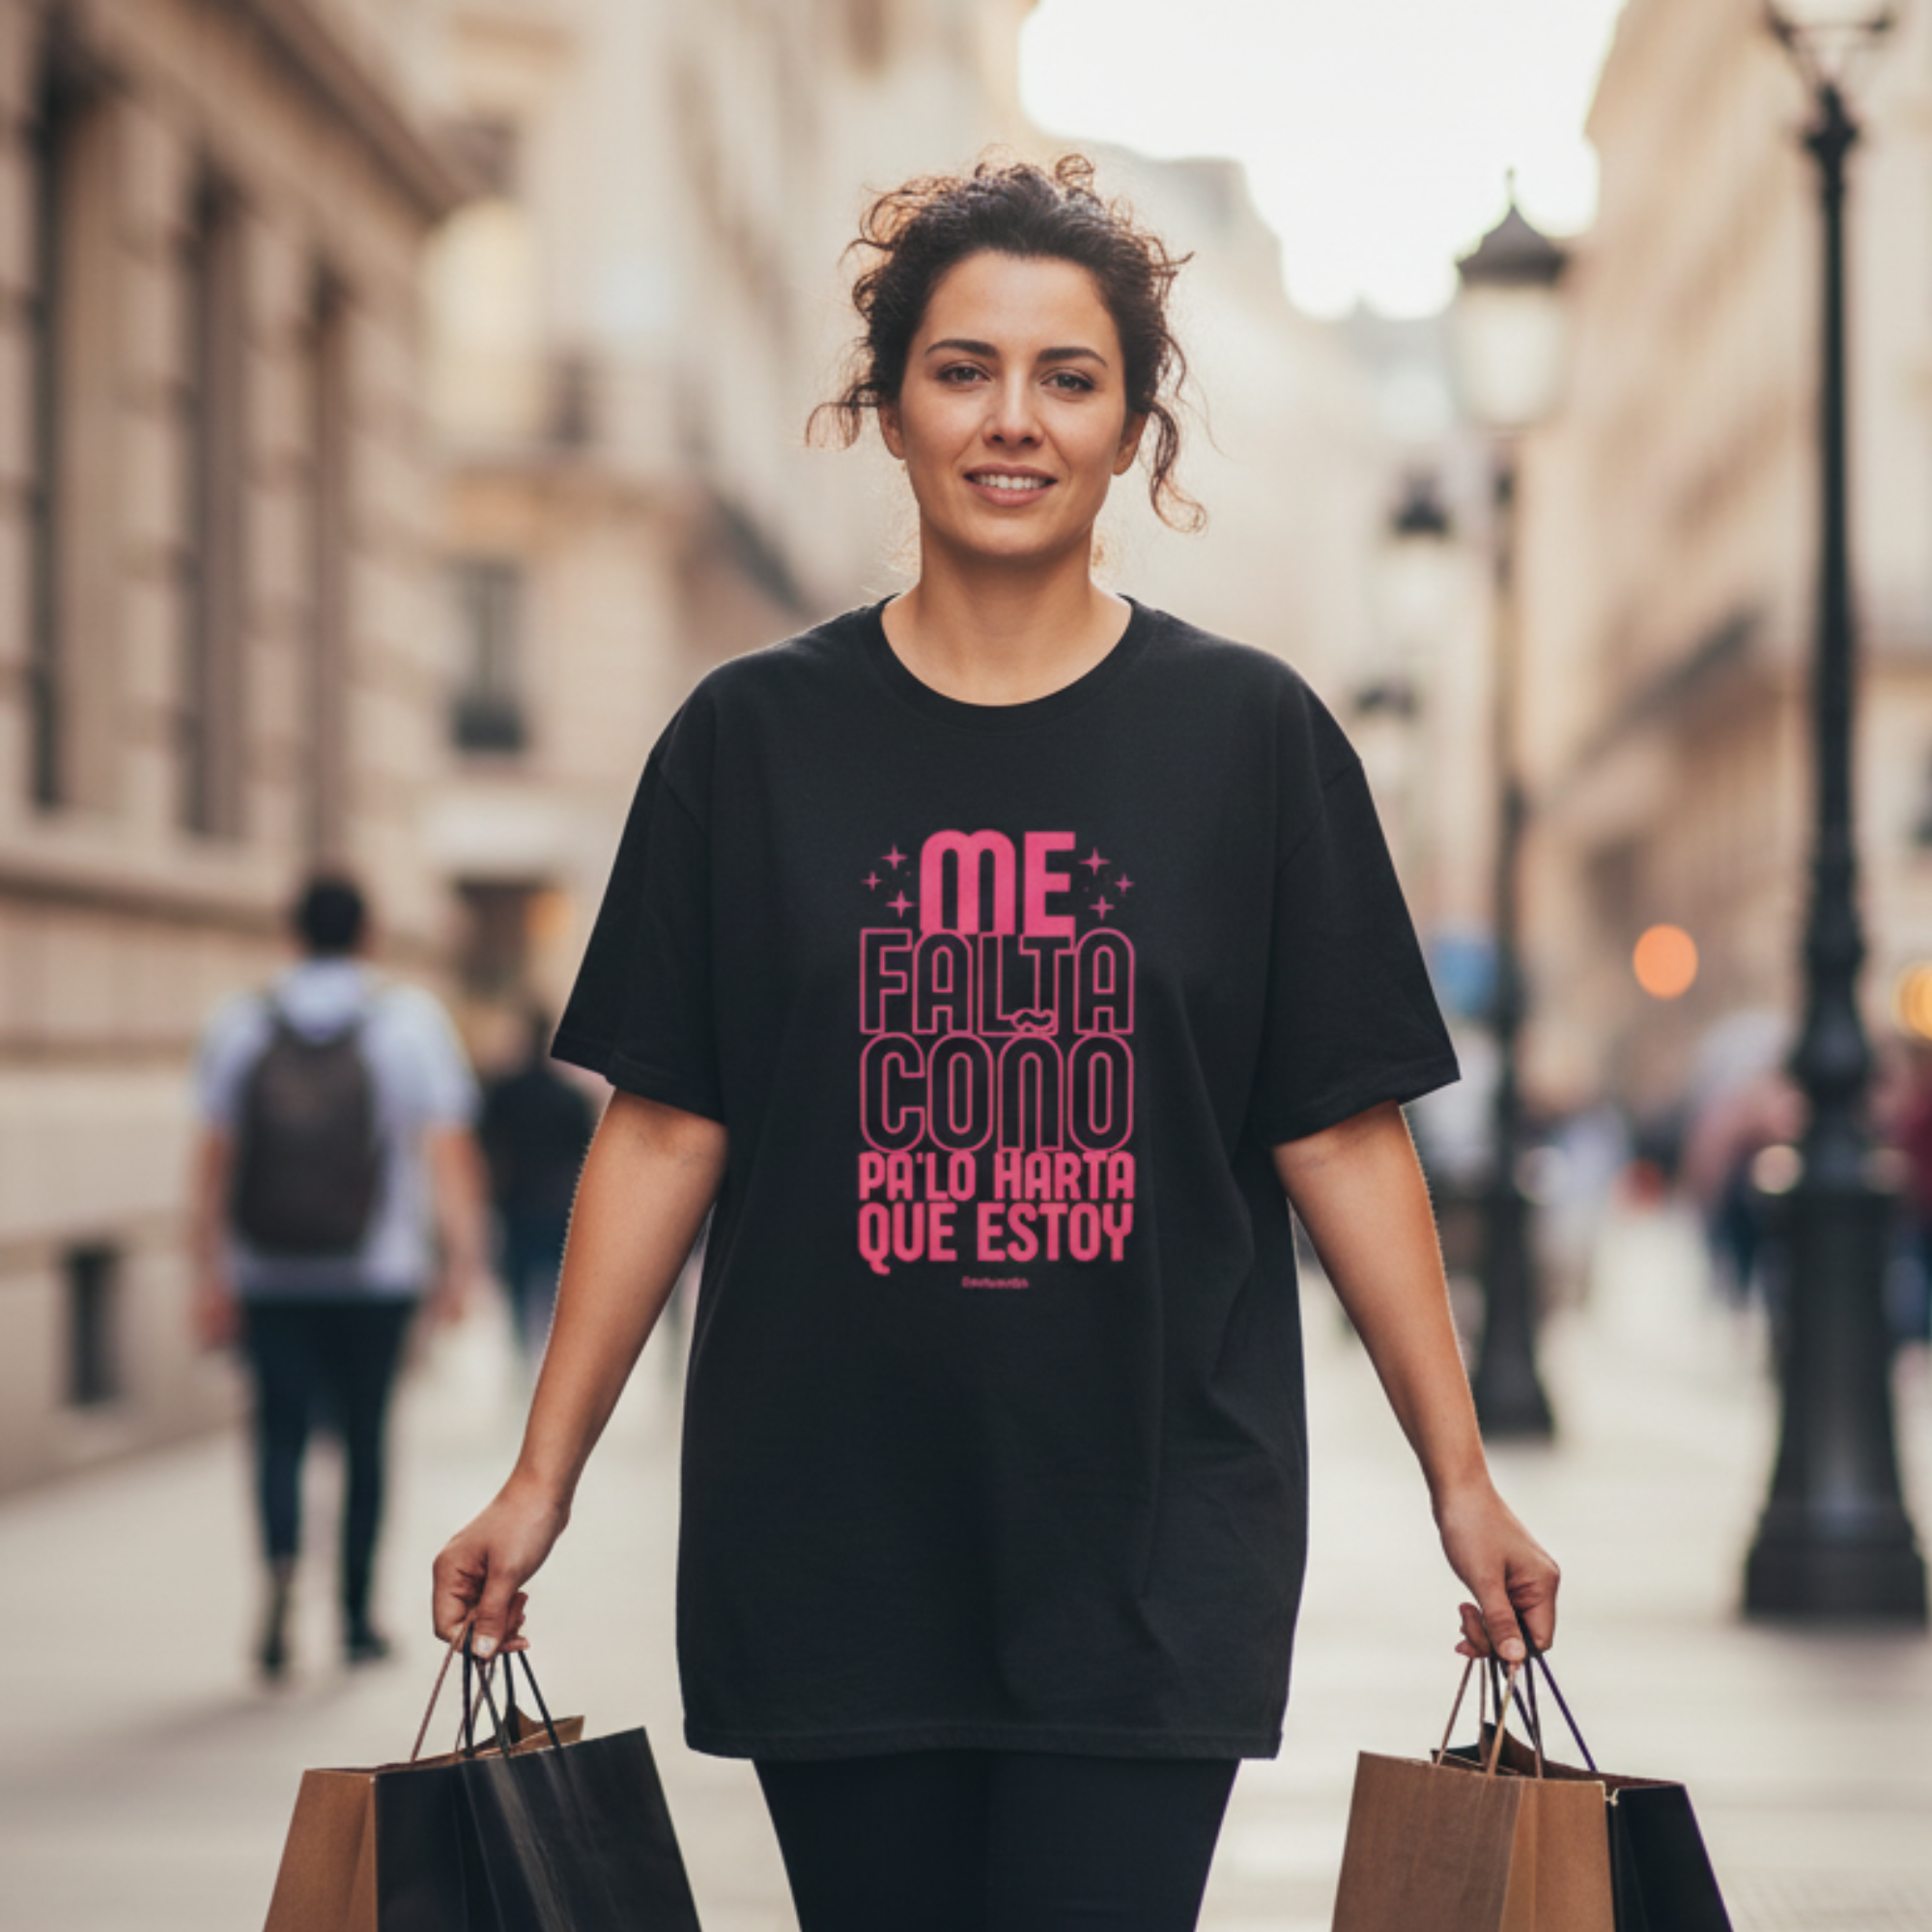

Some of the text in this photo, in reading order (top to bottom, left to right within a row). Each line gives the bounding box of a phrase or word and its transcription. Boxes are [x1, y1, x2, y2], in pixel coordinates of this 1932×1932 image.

[920, 829, 1075, 937] ME
[860, 927, 1135, 1037] FALTA
[993, 1149, 1135, 1202] HARTA
[858, 1202, 1133, 1275] QUE ESTOY
